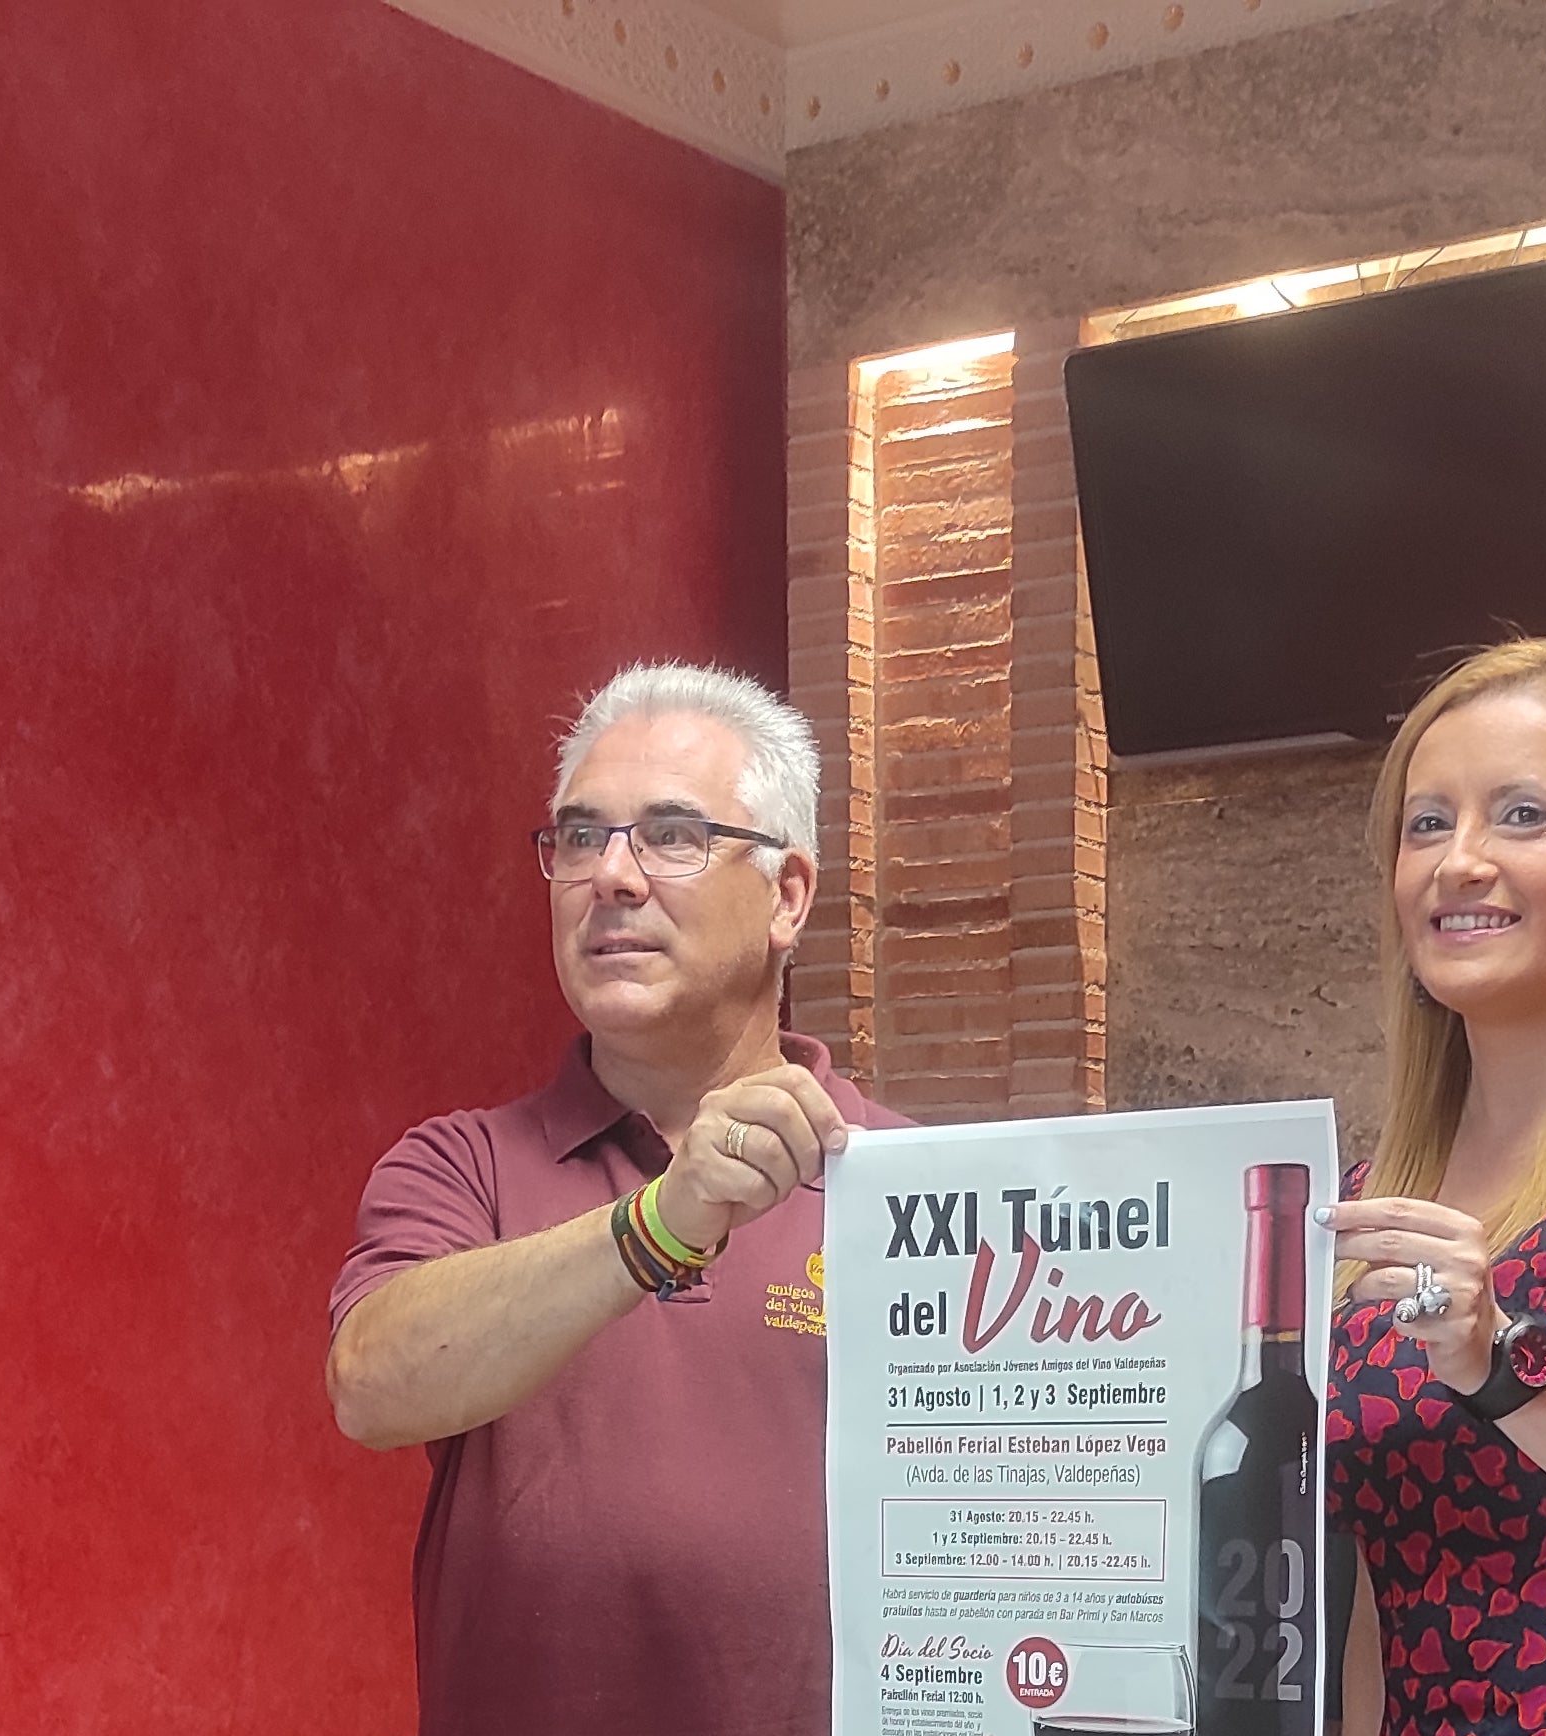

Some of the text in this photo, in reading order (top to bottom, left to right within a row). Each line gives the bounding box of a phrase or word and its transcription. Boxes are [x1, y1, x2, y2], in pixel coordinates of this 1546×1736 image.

[884, 1182, 1170, 1259] XXI Túnel
[765, 1282, 816, 1300] amigos
[889, 1233, 1162, 1355] del Vino
[765, 1297, 820, 1316] del vino
[888, 1357, 1166, 1376] Organizado por Asociación Jóvenes Amigos del Vino Valdepeñas
[888, 1381, 1166, 1412] 31 Agosto 1, 2 y 3 Septiembre
[886, 1434, 1166, 1456] Pabellón Ferial Esteban López Vega
[906, 1463, 1141, 1487] (Avda. de las Tinajas, Valdepeñas)
[950, 1510, 1095, 1525] 31 Agosto: 20.15 22.45 h.
[932, 1532, 1113, 1547] 1 y 2 Septiembre: 20.15 22.45 h.
[895, 1553, 903, 1565] 3
[905, 1552, 966, 1567] Septiembre:
[970, 1554, 999, 1567] 12.00
[1011, 1554, 1041, 1567] 14.00
[1044, 1554, 1054, 1567] h.
[1067, 1554, 1098, 1568] 20.15
[1141, 1555, 1151, 1568] h.
[1216, 1538, 1305, 1619] 20
[941, 1589, 951, 1601] de
[953, 1590, 996, 1603] guardería
[998, 1592, 1017, 1604] para
[1018, 1590, 1041, 1602] niños
[1043, 1591, 1054, 1603] de
[1055, 1591, 1062, 1603] 3
[1072, 1591, 1083, 1603] 14
[1085, 1592, 1106, 1604] años
[1107, 1595, 1114, 1606] y
[883, 1606, 923, 1619] gratuitos
[925, 1606, 948, 1618] hasta
[950, 1607, 957, 1618] el
[959, 1607, 995, 1621] pabellón
[997, 1609, 1013, 1619] con
[1015, 1608, 1044, 1622] parada
[1046, 1611, 1058, 1620] en
[1060, 1608, 1075, 1621] Bar
[1102, 1612, 1109, 1624] y
[1110, 1610, 1128, 1622] San
[1130, 1610, 1164, 1623] Marcos
[917, 1635, 947, 1658] del
[948, 1635, 994, 1660] Socio
[1012, 1650, 1065, 1687] 10€
[1215, 1622, 1303, 1701] 22
[881, 1664, 983, 1687] 4 Septiembre
[881, 1688, 984, 1704] Pabellón Ferial 12:00 h.
[1019, 1687, 1055, 1698] ENTRADA
